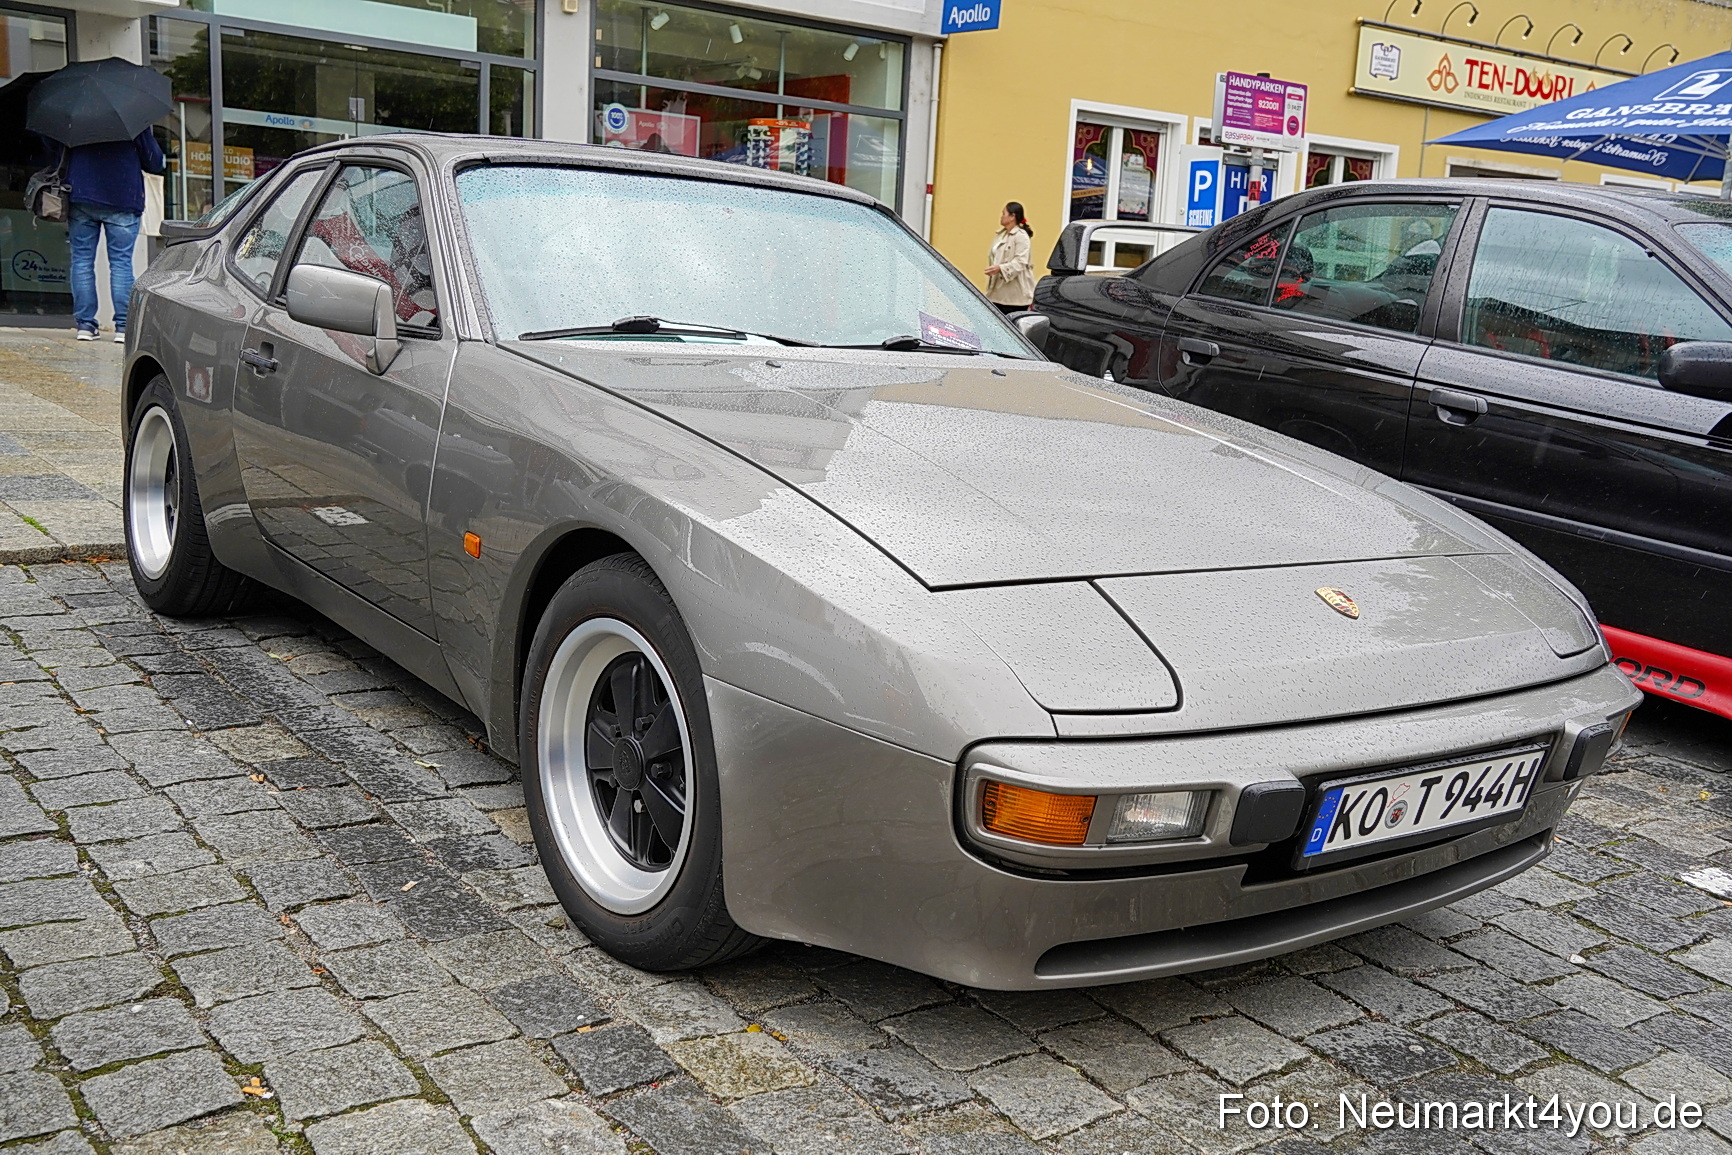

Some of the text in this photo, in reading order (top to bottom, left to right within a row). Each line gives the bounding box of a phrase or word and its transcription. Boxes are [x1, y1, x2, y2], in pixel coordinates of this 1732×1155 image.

[948, 3, 991, 28] Apollo
[1229, 76, 1285, 94] HANDYPARKEN
[1258, 100, 1280, 111] 923001
[265, 114, 295, 126] Apollo
[190, 151, 251, 165] HÖRUDIO
[1193, 170, 1213, 202] P
[1230, 170, 1268, 192] HIR
[1188, 209, 1213, 226] SCHEINE
[21, 259, 38, 271] 24
[1327, 757, 1540, 844] KO T 944H
[1310, 827, 1322, 843] D
